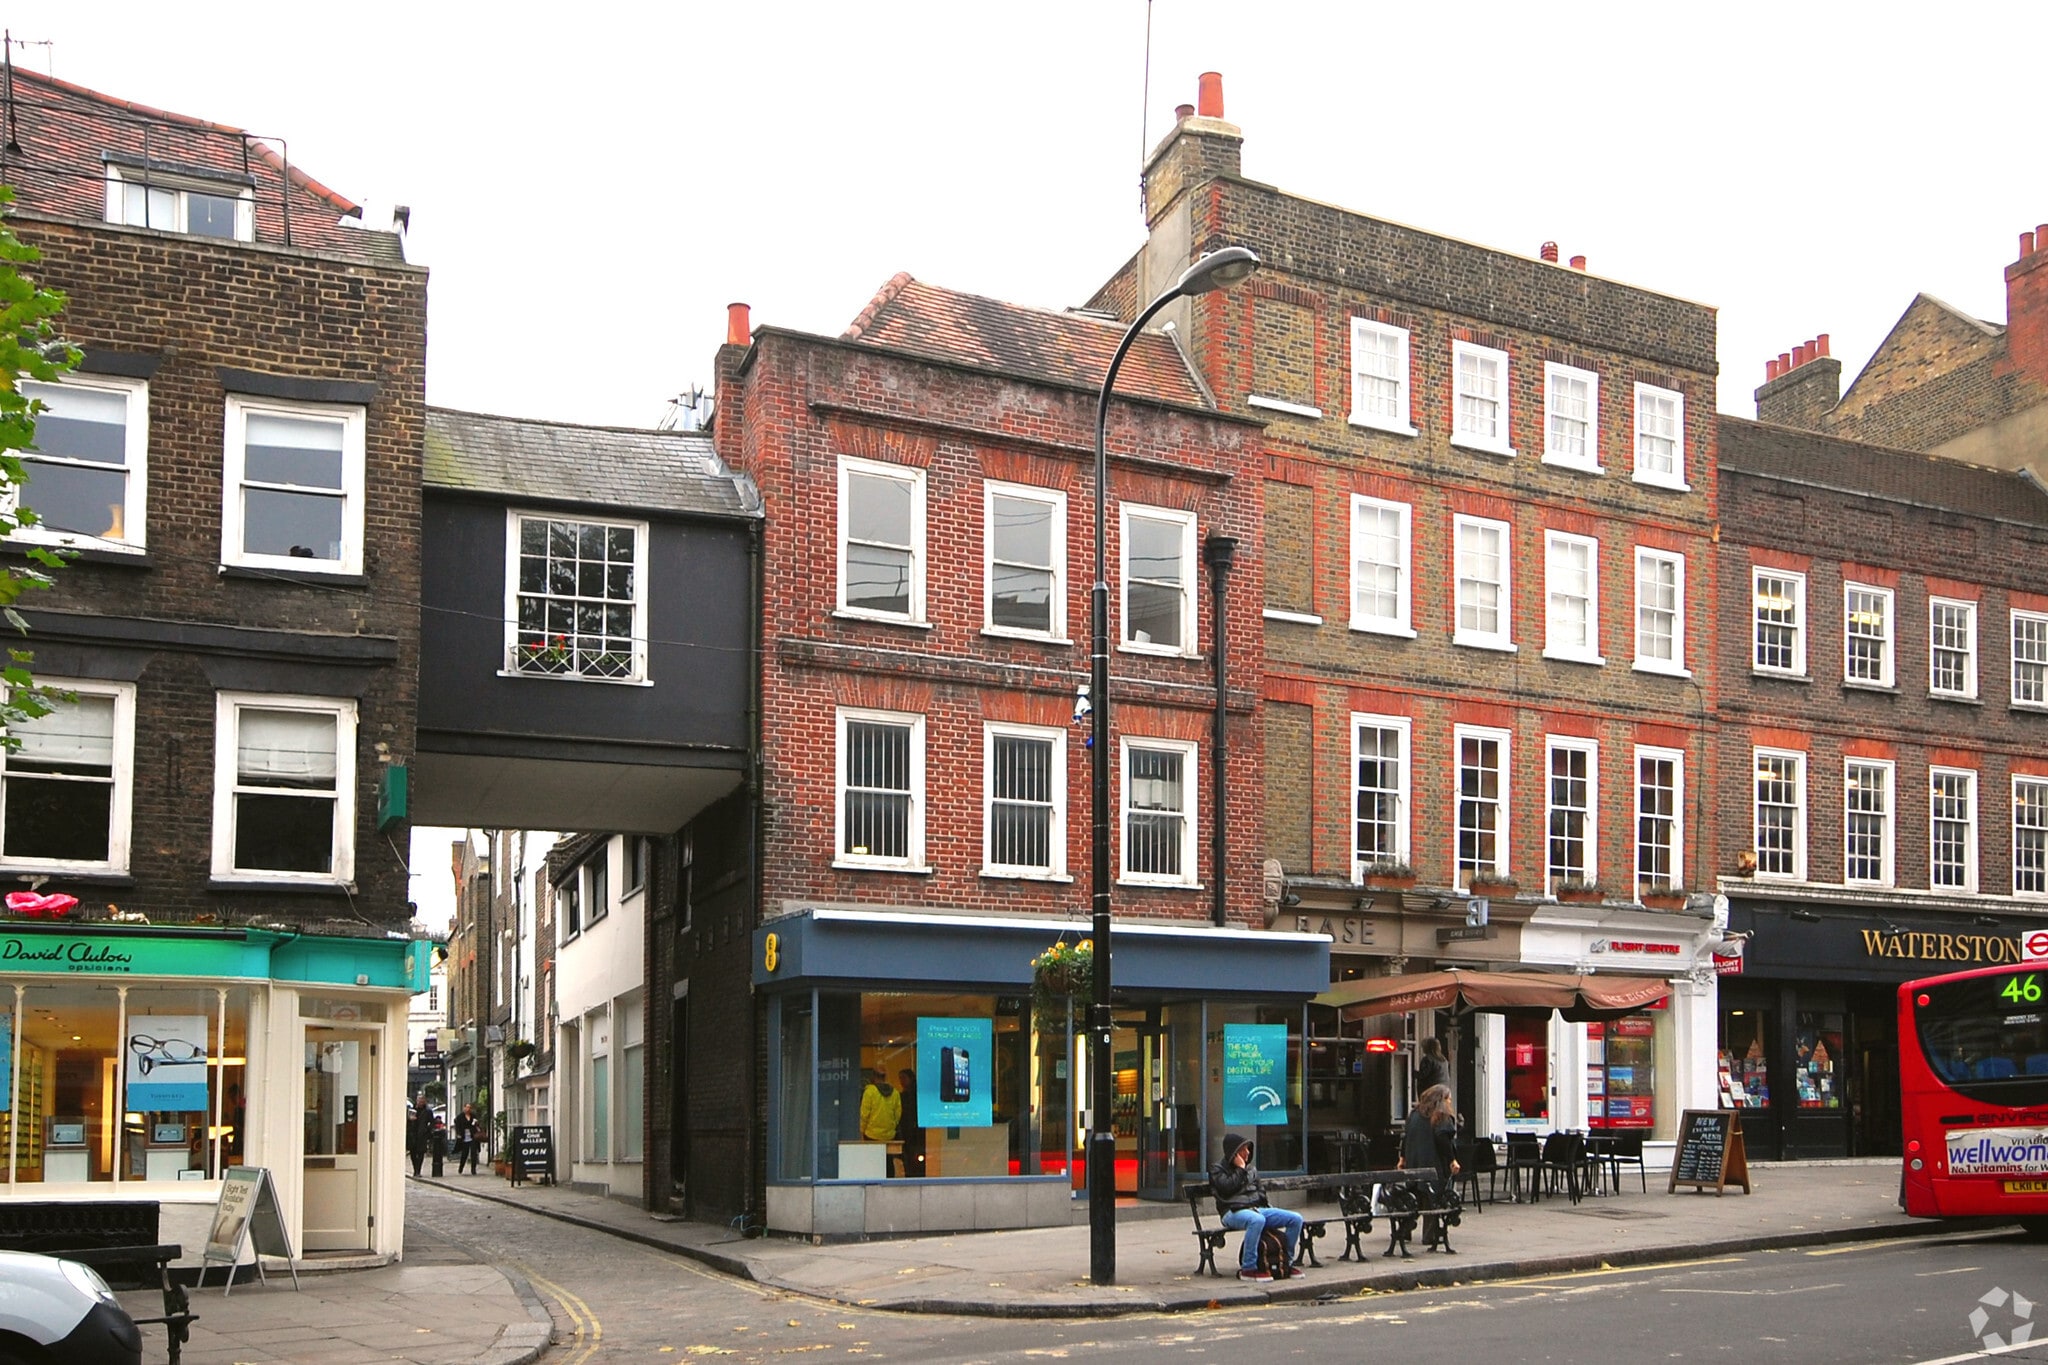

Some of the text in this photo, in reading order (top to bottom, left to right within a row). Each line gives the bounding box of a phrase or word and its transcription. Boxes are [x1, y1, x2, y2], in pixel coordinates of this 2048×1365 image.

[1296, 915, 1375, 945] BASE
[2, 940, 132, 963] David Clulow
[1611, 941, 1681, 954] FLIGHT CENTRE
[68, 964, 130, 973] opticians
[2001, 974, 2042, 1003] 46
[1390, 990, 1446, 1006] BASE BISTRO
[1103, 1034, 1110, 1043] 8
[1695, 1117, 1718, 1126] NEW
[1949, 1139, 2048, 1164] wellwom
[1951, 1164, 1971, 1174] No.1
[1974, 1162, 2022, 1173] vitamins
[226, 1184, 249, 1195] Sight Test
[222, 1202, 235, 1214] Today
